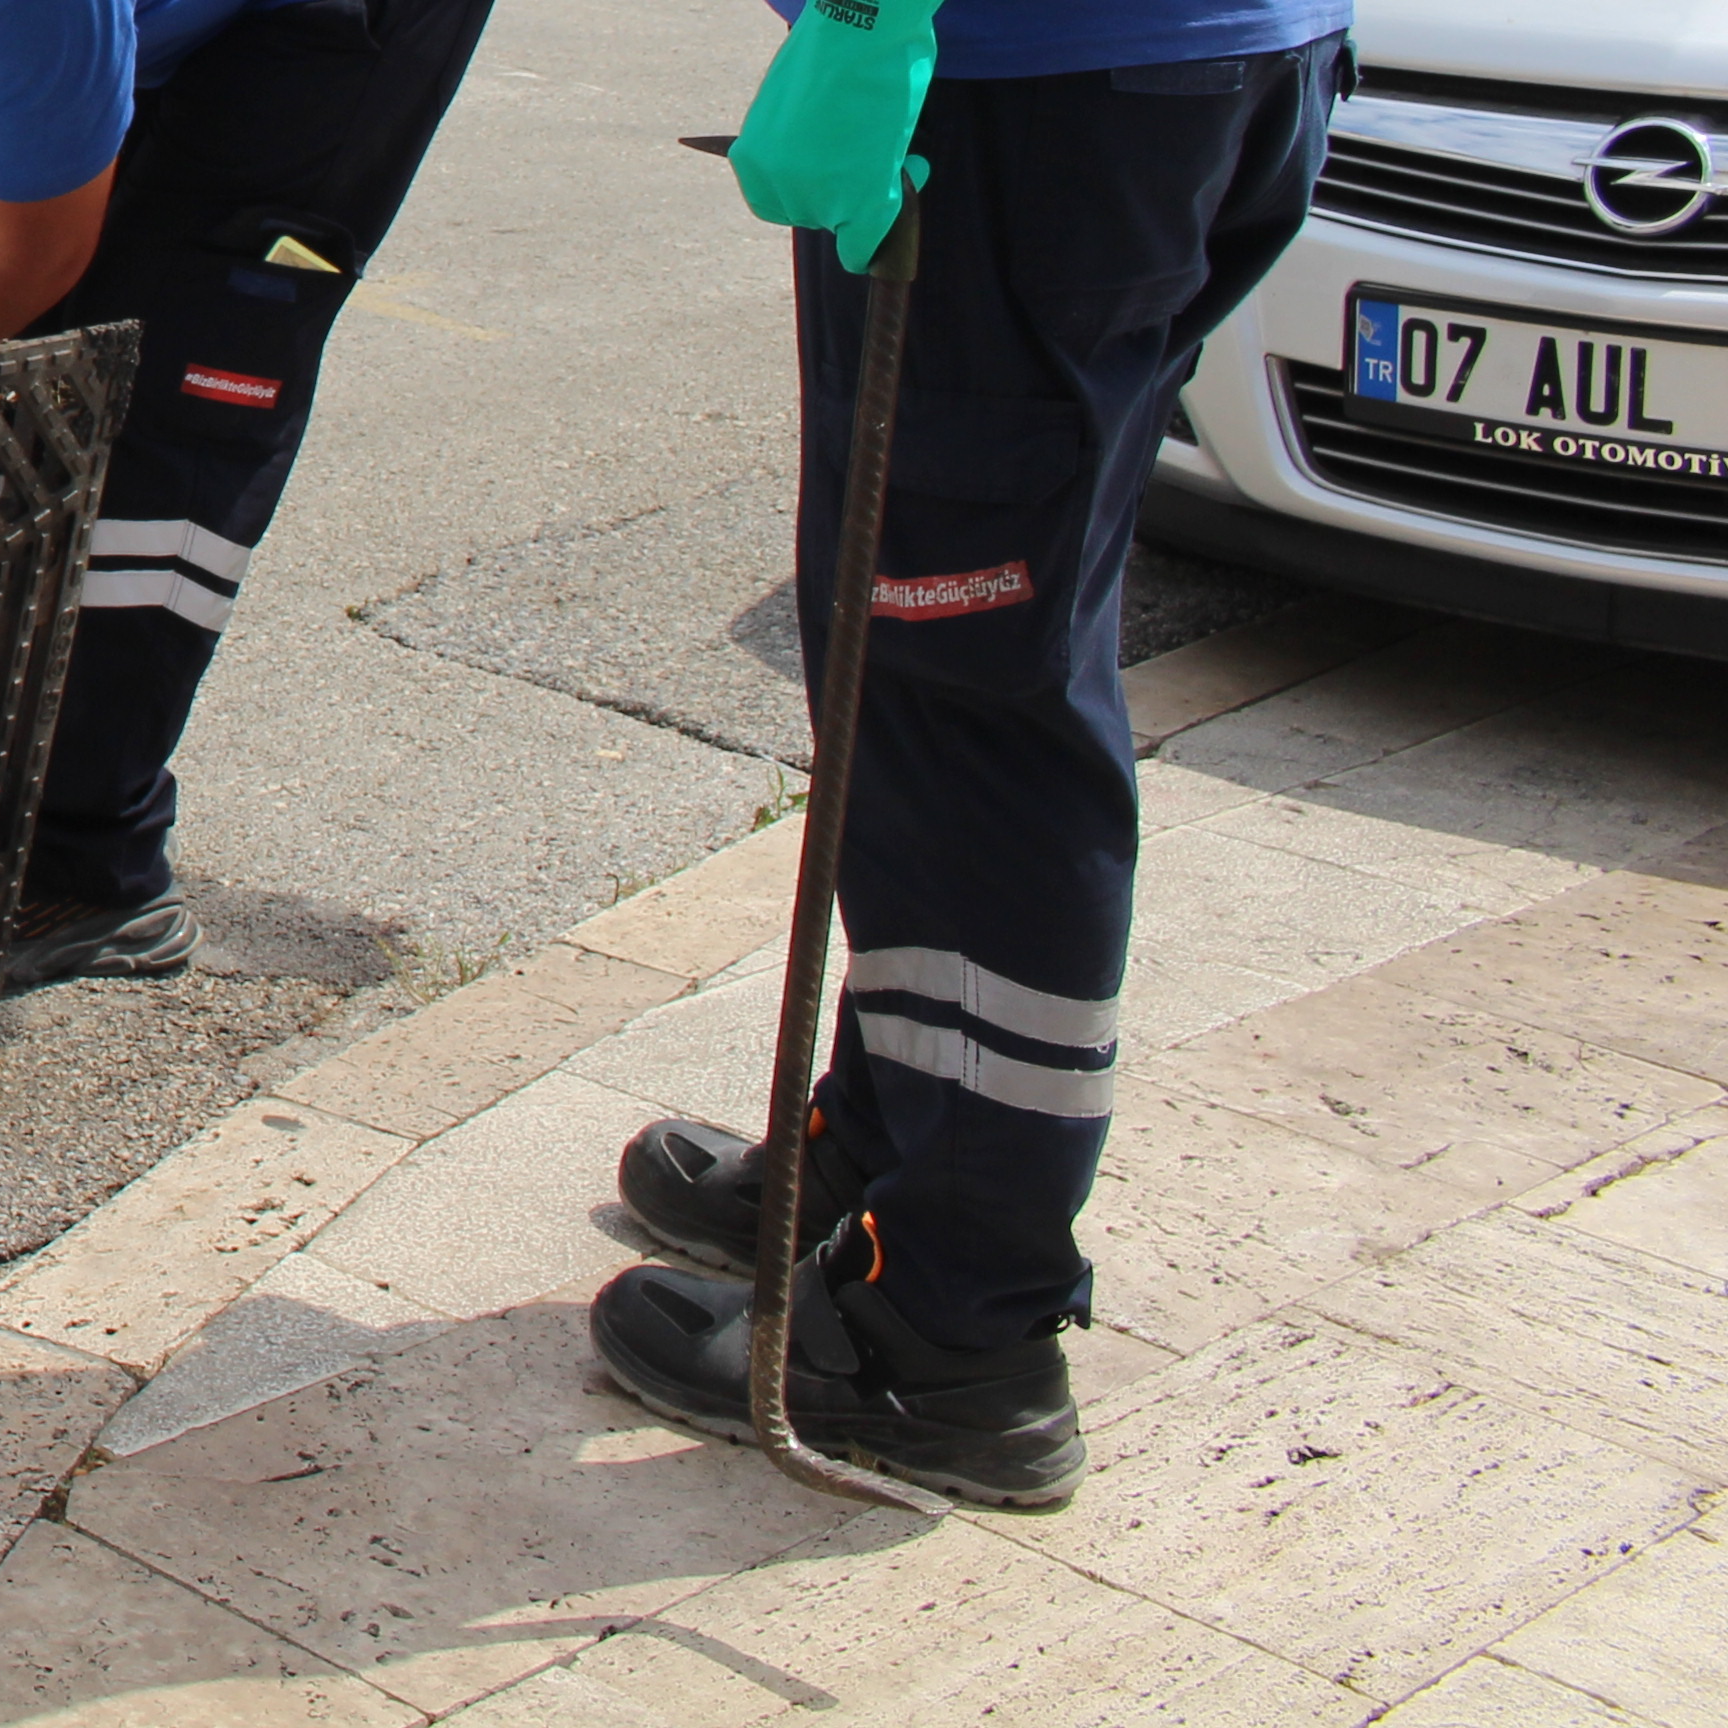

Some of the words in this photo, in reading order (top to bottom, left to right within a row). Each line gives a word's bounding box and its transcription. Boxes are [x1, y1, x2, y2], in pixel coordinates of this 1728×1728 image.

[1365, 358, 1393, 383] TR
[1399, 317, 1487, 402] 07
[1525, 336, 1673, 435] AUL
[1474, 422, 1543, 452] LOK
[871, 570, 1021, 608] zBirlikteGüçlüyüz
